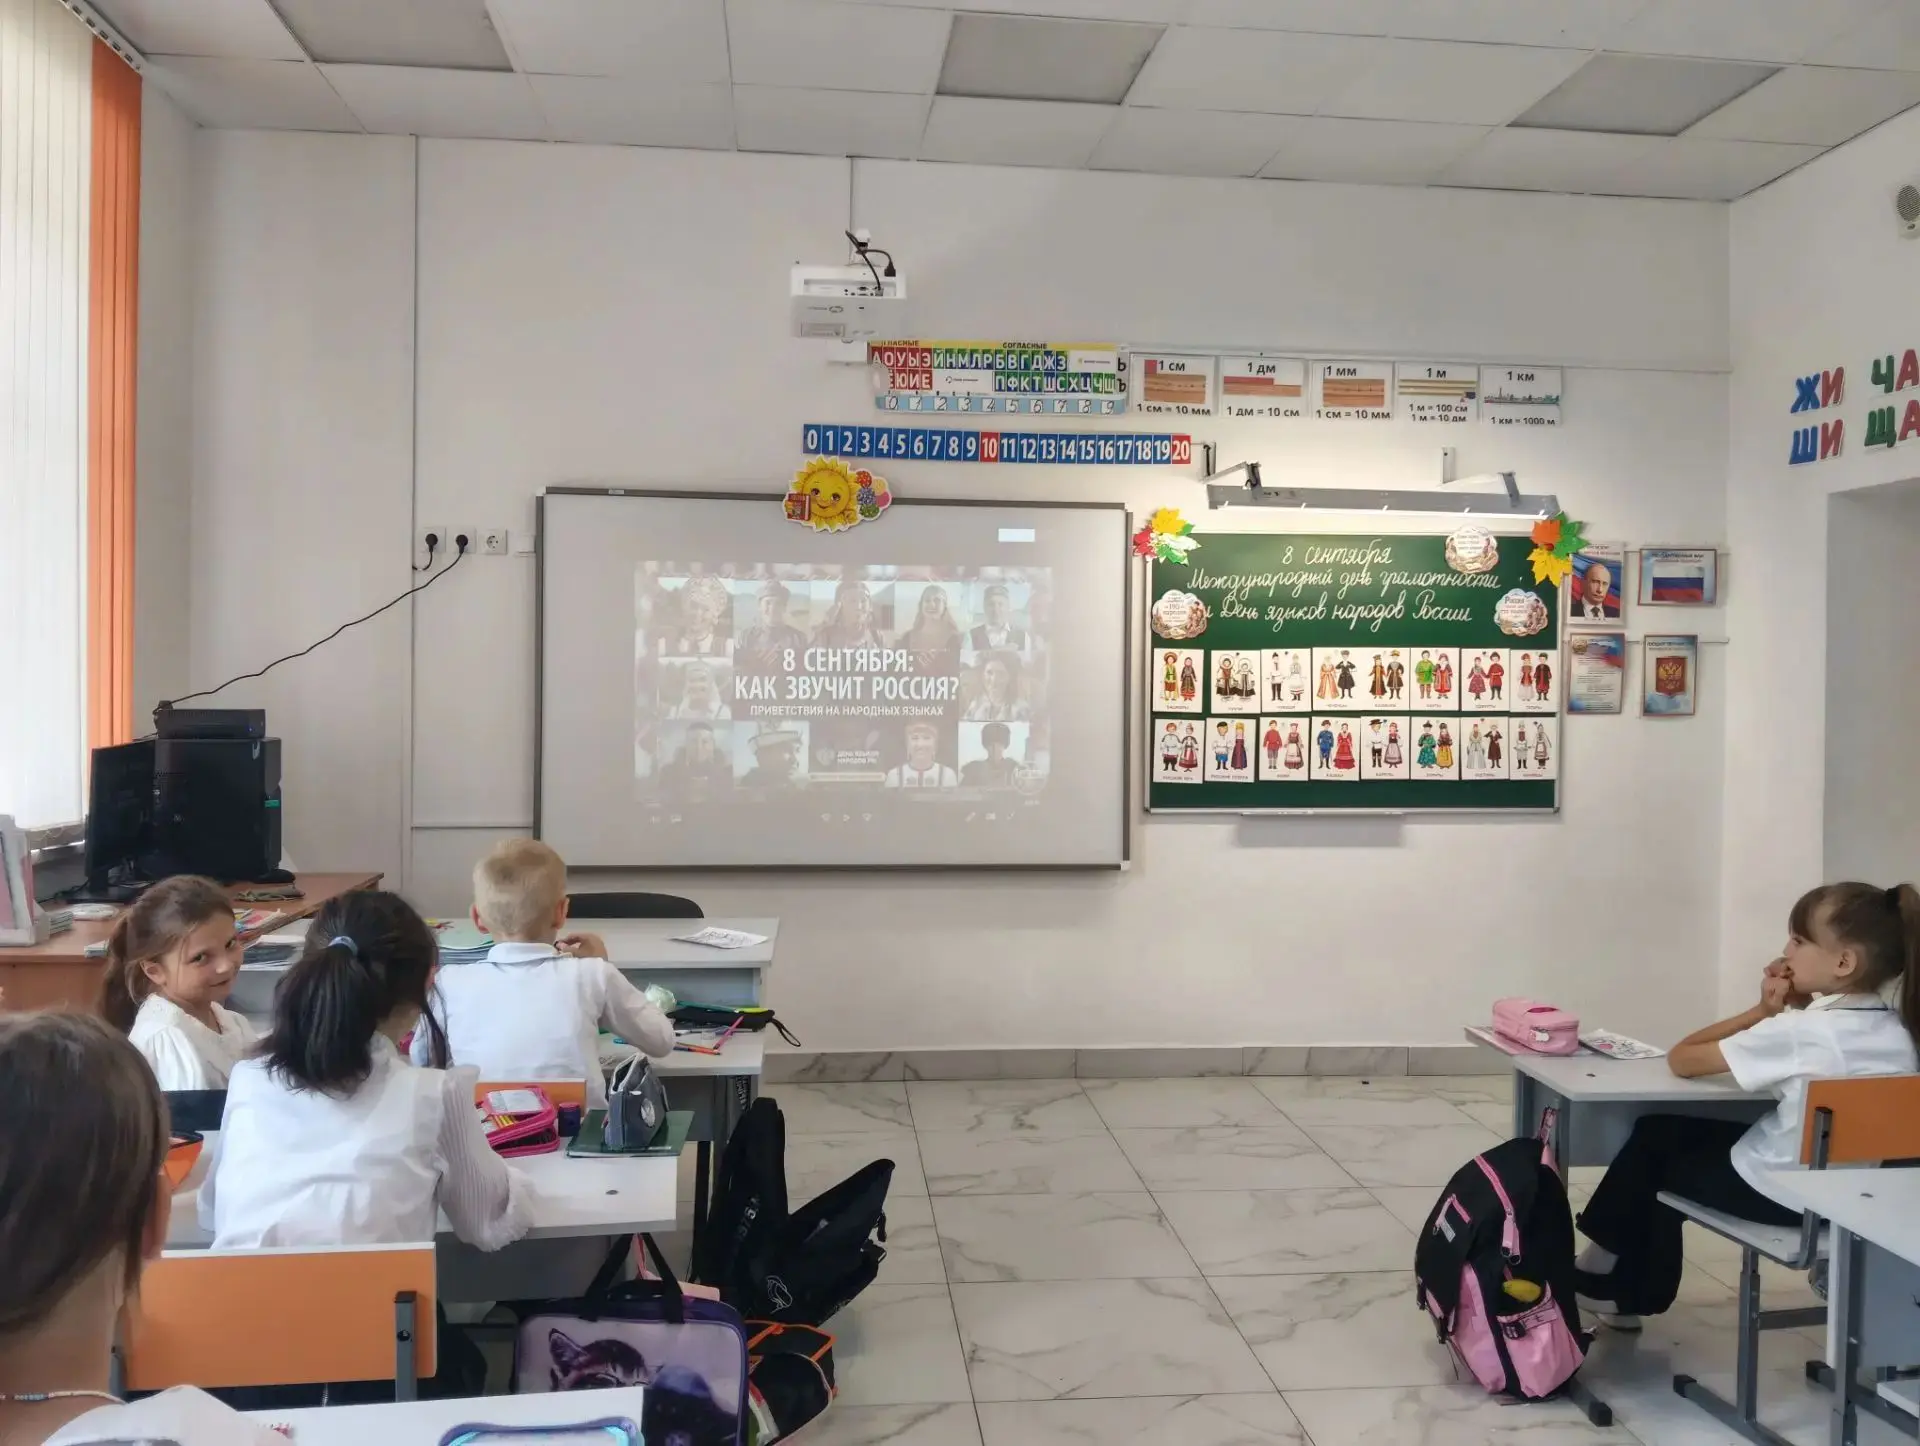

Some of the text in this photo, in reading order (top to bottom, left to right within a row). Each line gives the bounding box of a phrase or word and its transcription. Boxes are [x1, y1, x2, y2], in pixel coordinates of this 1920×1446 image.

[1002, 342, 1048, 350] СОГЛАСНЫЕ
[1158, 360, 1185, 372] 1 см
[1247, 362, 1276, 375] 1 дм
[1325, 365, 1357, 377] 1 мм
[1871, 349, 1920, 394] ЧА
[1426, 367, 1447, 379] 1 м
[1507, 371, 1535, 382] 1 км
[1790, 366, 1844, 414] ЖИ
[1137, 403, 1142, 413] 1
[1146, 406, 1162, 414] см
[1176, 405, 1188, 415] 10
[1192, 408, 1211, 416] мм
[1227, 406, 1232, 416] 1
[1235, 408, 1254, 417] дм
[1267, 407, 1281, 417] 10
[1316, 410, 1322, 419] 1
[1355, 410, 1368, 419] 10
[1409, 403, 1414, 412] 1
[1436, 404, 1453, 413] 100
[1454, 405, 1468, 413] см
[1411, 414, 1416, 422] 1
[1438, 414, 1450, 422] 10
[1451, 415, 1466, 423] дм
[1491, 416, 1496, 424] 1
[1523, 417, 1545, 425] 1000
[1864, 399, 1920, 448] ЩА
[807, 429, 1189, 461] 0 1 2 3 4 5 6 7 8 9 10 11 12 13 14 15 16 17 18 19 20
[1788, 418, 1844, 465] ШИ
[1282, 546, 1294, 565] 8
[1187, 568, 1502, 600] Международный день грамотности
[1220, 594, 1259, 620] День
[1265, 591, 1328, 632] языков
[1332, 589, 1407, 633] народов
[1412, 589, 1472, 622] России
[783, 648, 914, 673] 8 СЕНТЯБРЯ:
[735, 675, 960, 701] КАК ЗВУЧИТ РОССИЯ?
[750, 705, 944, 717] ПРИВЕТСТВИЯ НА НАРОДНЫХ ЯЗЫКАХ
